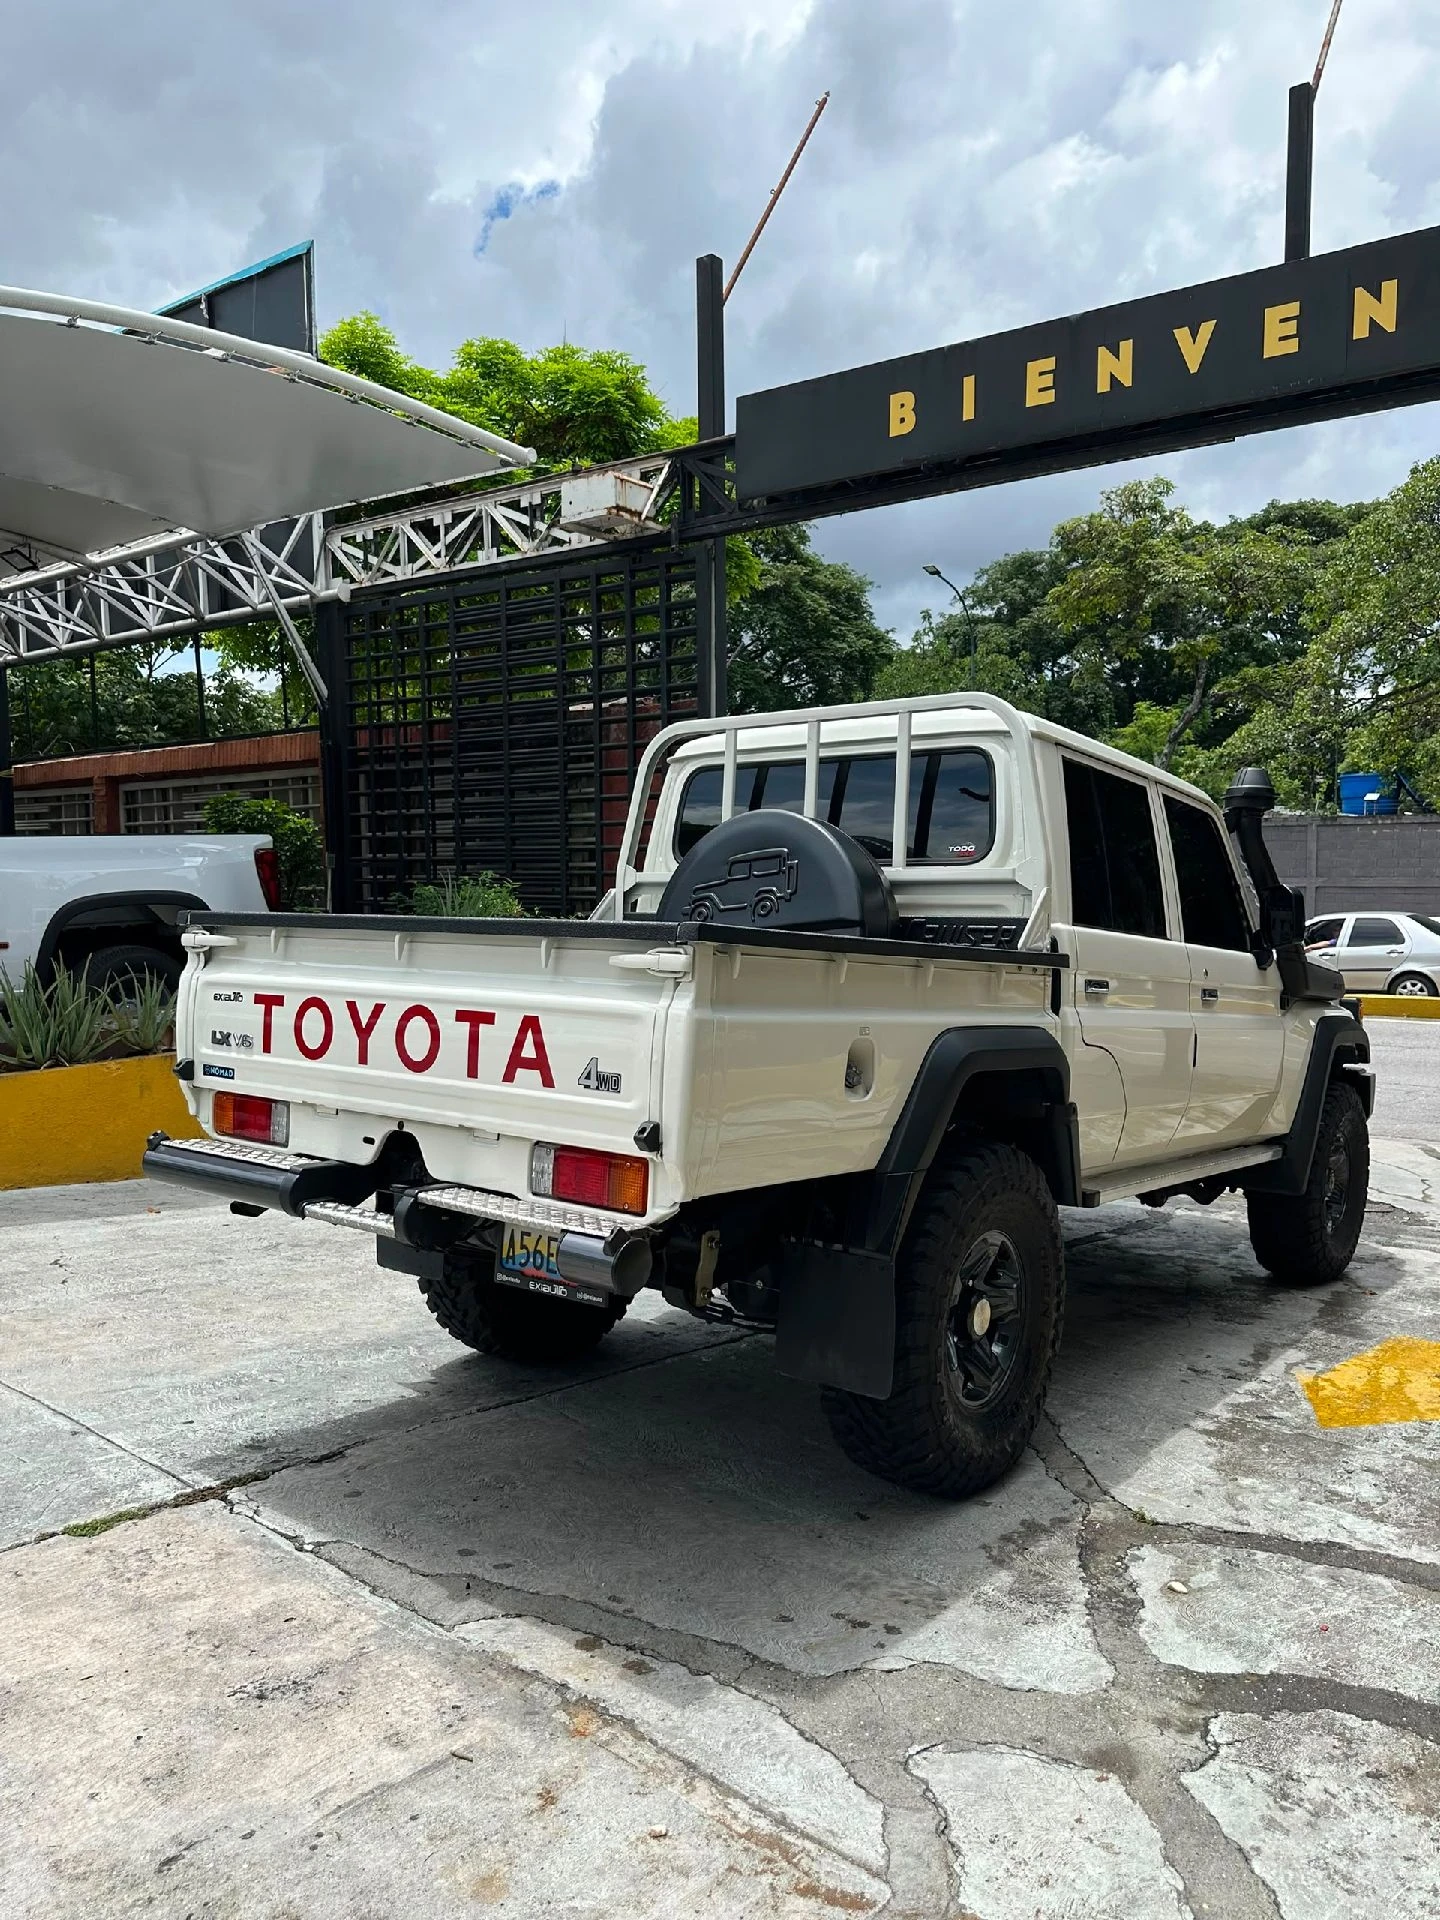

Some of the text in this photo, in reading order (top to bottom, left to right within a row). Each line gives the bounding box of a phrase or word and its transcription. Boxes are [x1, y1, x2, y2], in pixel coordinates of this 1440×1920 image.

[889, 278, 1398, 438] BIENVEN
[211, 1029, 231, 1046] LX
[253, 993, 556, 1089] TOYOTA
[210, 1066, 234, 1077] NOMAD
[577, 1056, 621, 1093] 4WD
